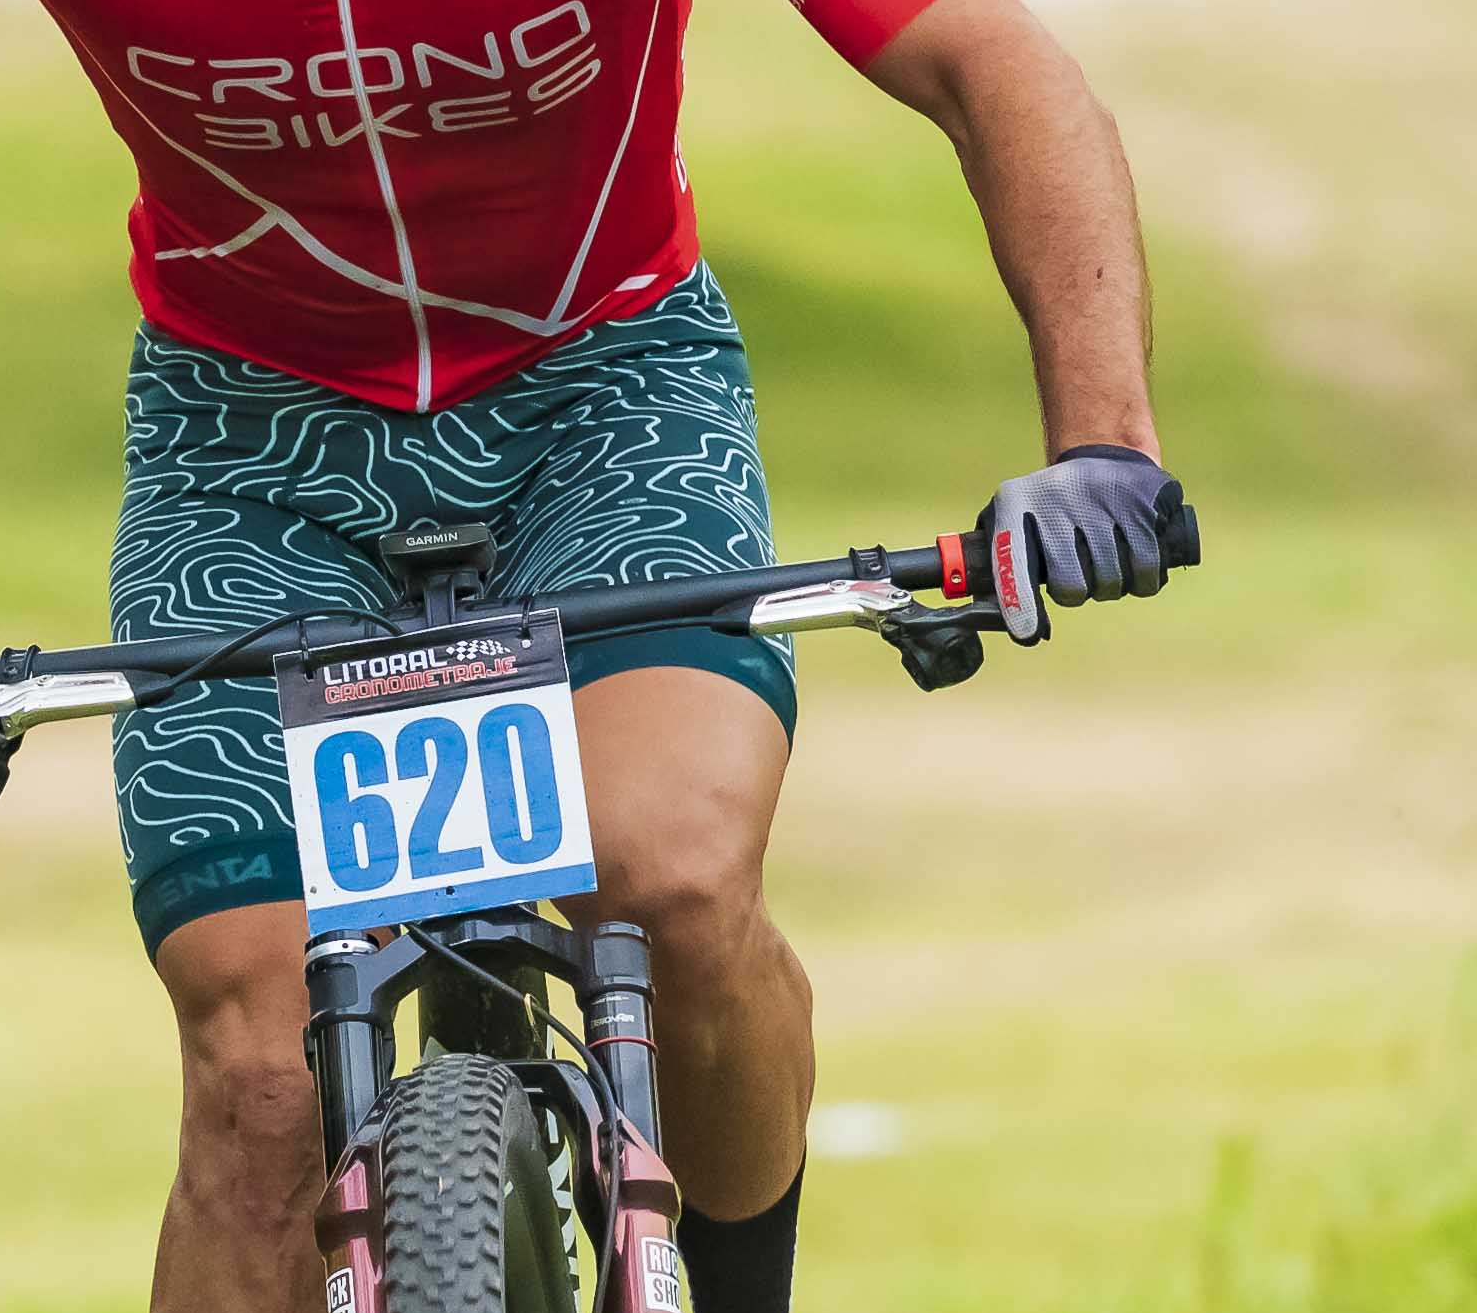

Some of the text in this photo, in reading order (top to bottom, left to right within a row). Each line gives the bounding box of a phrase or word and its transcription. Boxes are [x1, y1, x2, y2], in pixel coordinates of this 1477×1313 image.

[127, 0, 591, 103] CRONO
[195, 43, 602, 150] BIKES
[406, 531, 458, 547] GARMIN
[323, 648, 447, 685] LITORAL
[324, 655, 519, 705] CRONOMETRAJE
[313, 703, 563, 893] 620
[648, 1243, 679, 1279] ROC
[329, 1275, 349, 1310] CK
